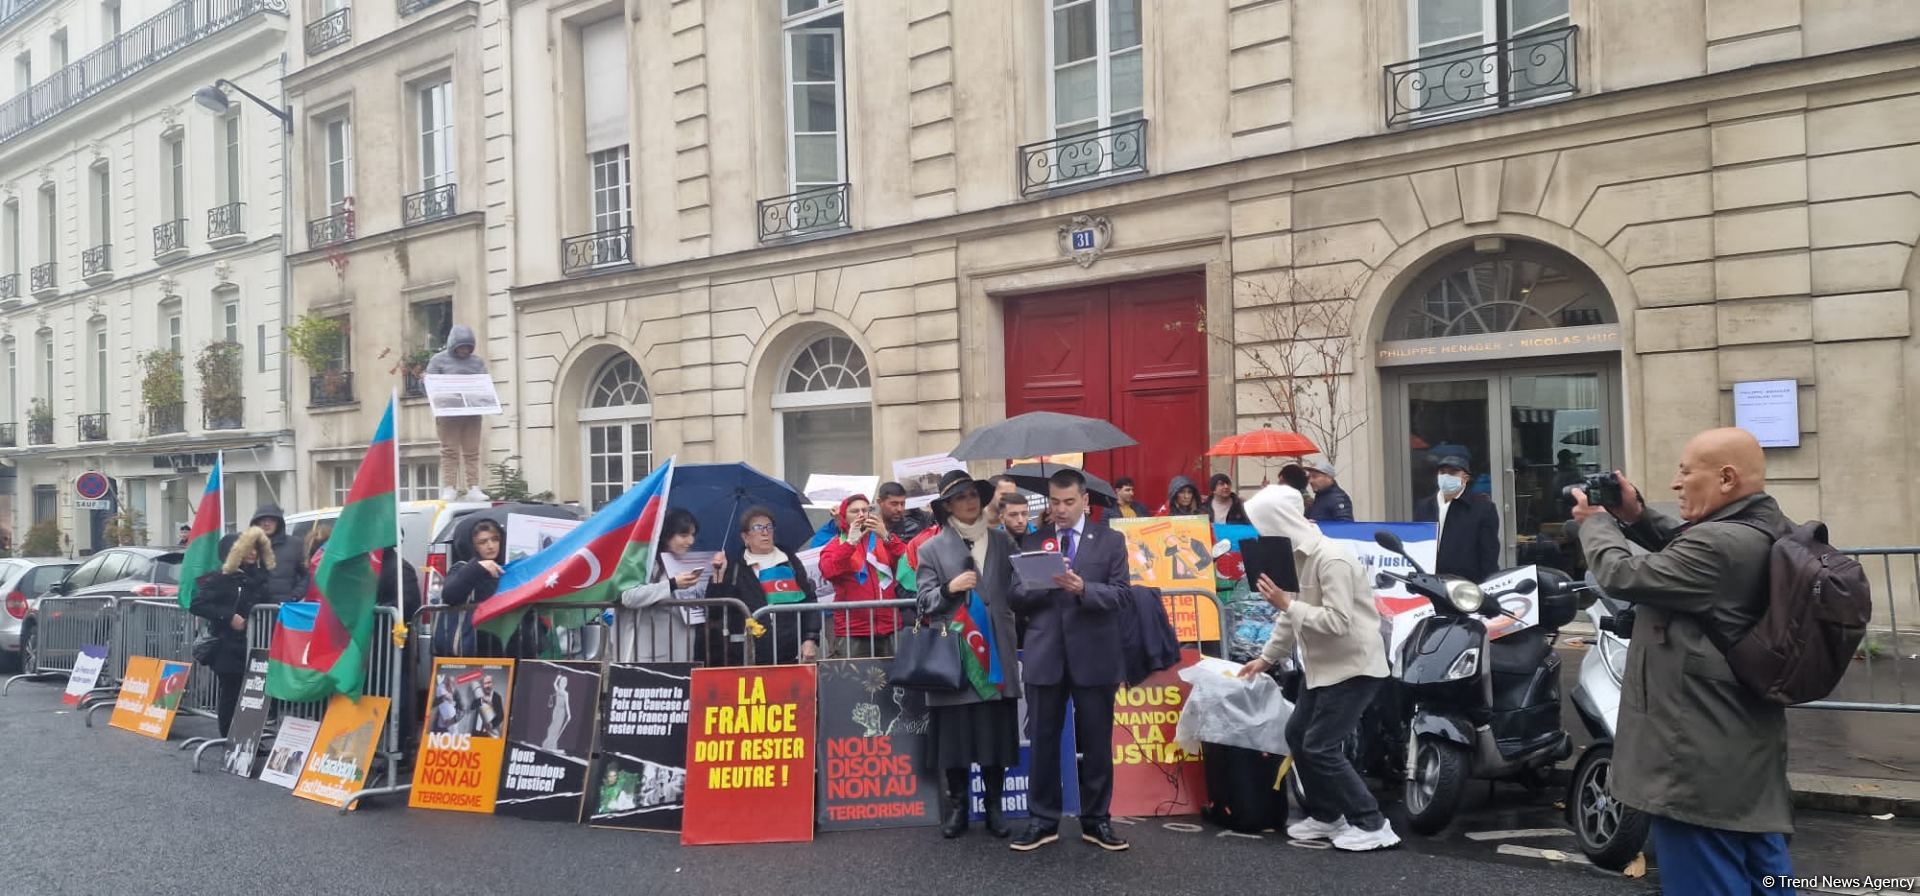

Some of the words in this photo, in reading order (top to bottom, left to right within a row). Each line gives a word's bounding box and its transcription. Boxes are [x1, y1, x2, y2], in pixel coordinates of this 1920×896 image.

[1076, 232, 1091, 248] 31
[1520, 335, 1581, 347] NICOLAS
[612, 686, 634, 699] Pour
[633, 687, 673, 700] apporter
[673, 686, 683, 699] la
[738, 677, 767, 705] LA
[1114, 686, 1182, 707] NOUS
[611, 699, 631, 711] Paix
[631, 700, 643, 711] au
[643, 698, 682, 712] Caucase
[610, 710, 627, 722] Sud
[627, 710, 638, 723] la
[638, 711, 669, 724] France
[669, 711, 689, 724] doit
[705, 703, 798, 735] FRANCE
[608, 724, 636, 735] rester
[636, 724, 667, 736] neutre
[1132, 724, 1166, 743] LA
[428, 731, 472, 751] NOUS
[694, 740, 735, 763] DOIT
[741, 737, 805, 760] RESTER
[827, 736, 892, 758] NOUS
[424, 751, 481, 770] DISONS
[510, 748, 536, 764] Nous
[508, 761, 567, 780] demandons
[827, 755, 912, 779] DISONS
[421, 768, 457, 787] NON
[458, 771, 482, 789] AU
[505, 774, 517, 789] la
[515, 774, 556, 793] justice!
[709, 765, 776, 789] NEUTRE
[782, 765, 789, 787] !
[827, 776, 881, 800] NON
[884, 774, 917, 797] AU
[417, 790, 483, 808] TERRORISME
[826, 801, 926, 821] TERRORISME
